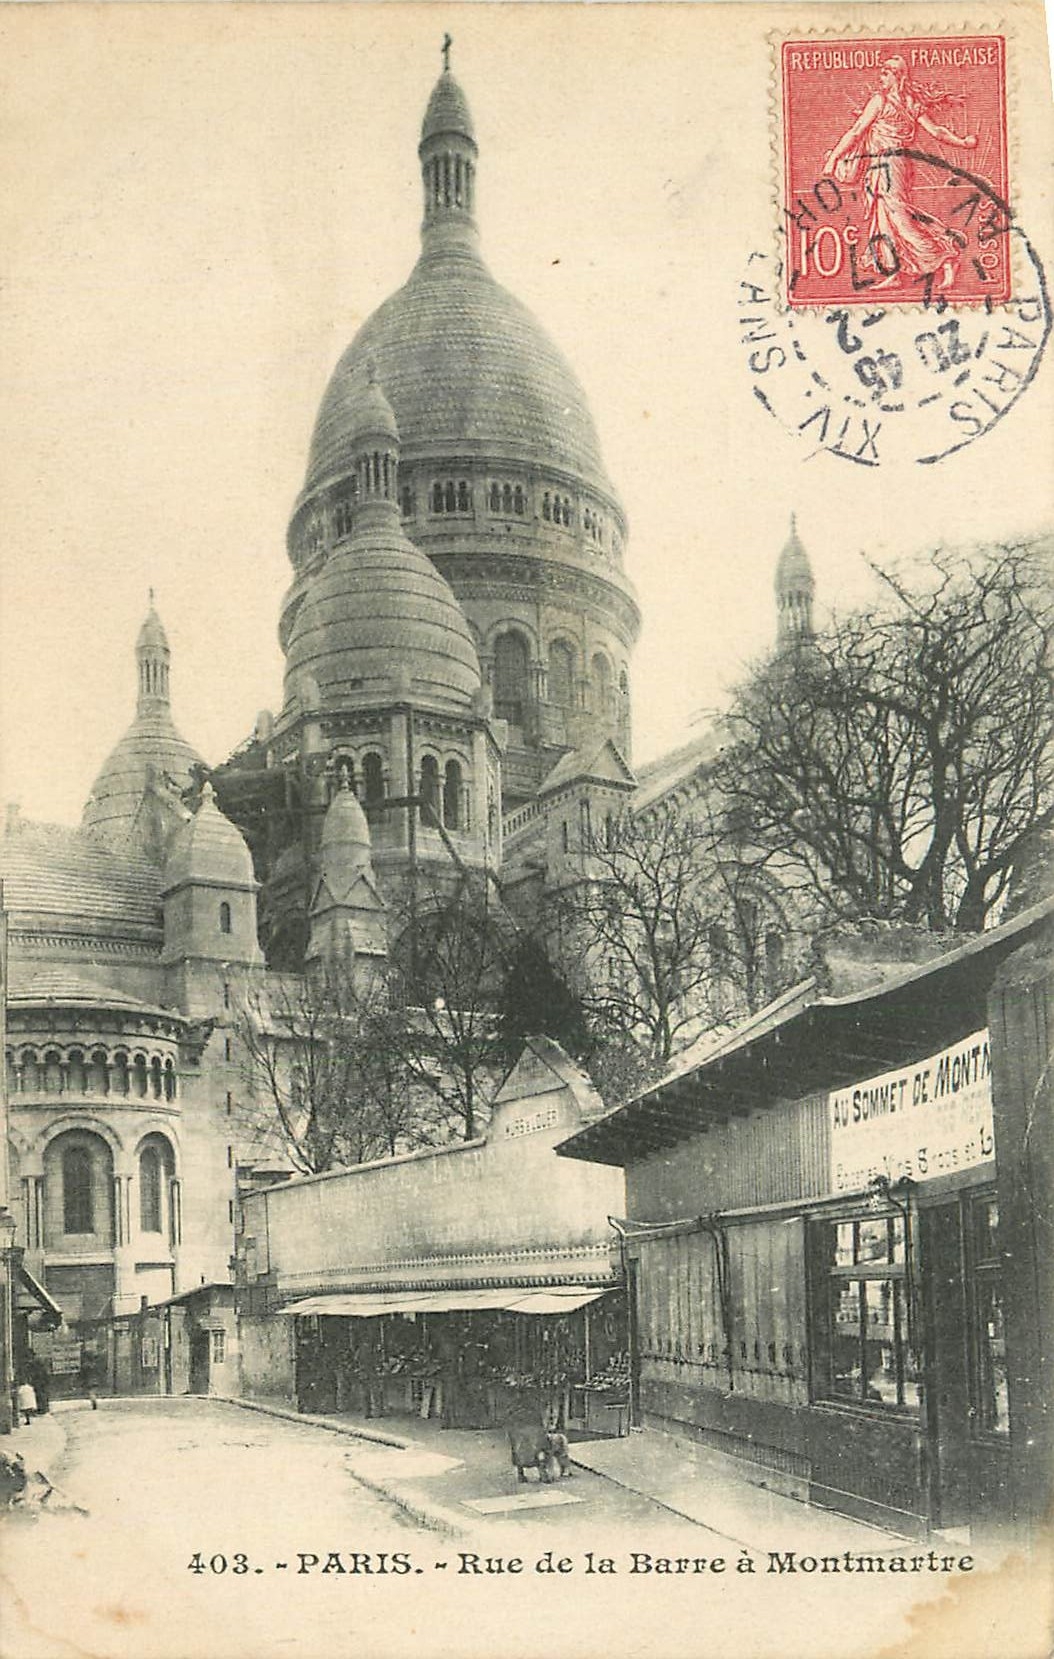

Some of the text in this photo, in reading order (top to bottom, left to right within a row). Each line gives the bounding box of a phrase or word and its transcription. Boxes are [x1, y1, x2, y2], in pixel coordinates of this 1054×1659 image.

[791, 50, 883, 71] REPUBLIQUE
[833, 1098, 849, 1129] AU
[852, 1078, 908, 1123] SOMMET
